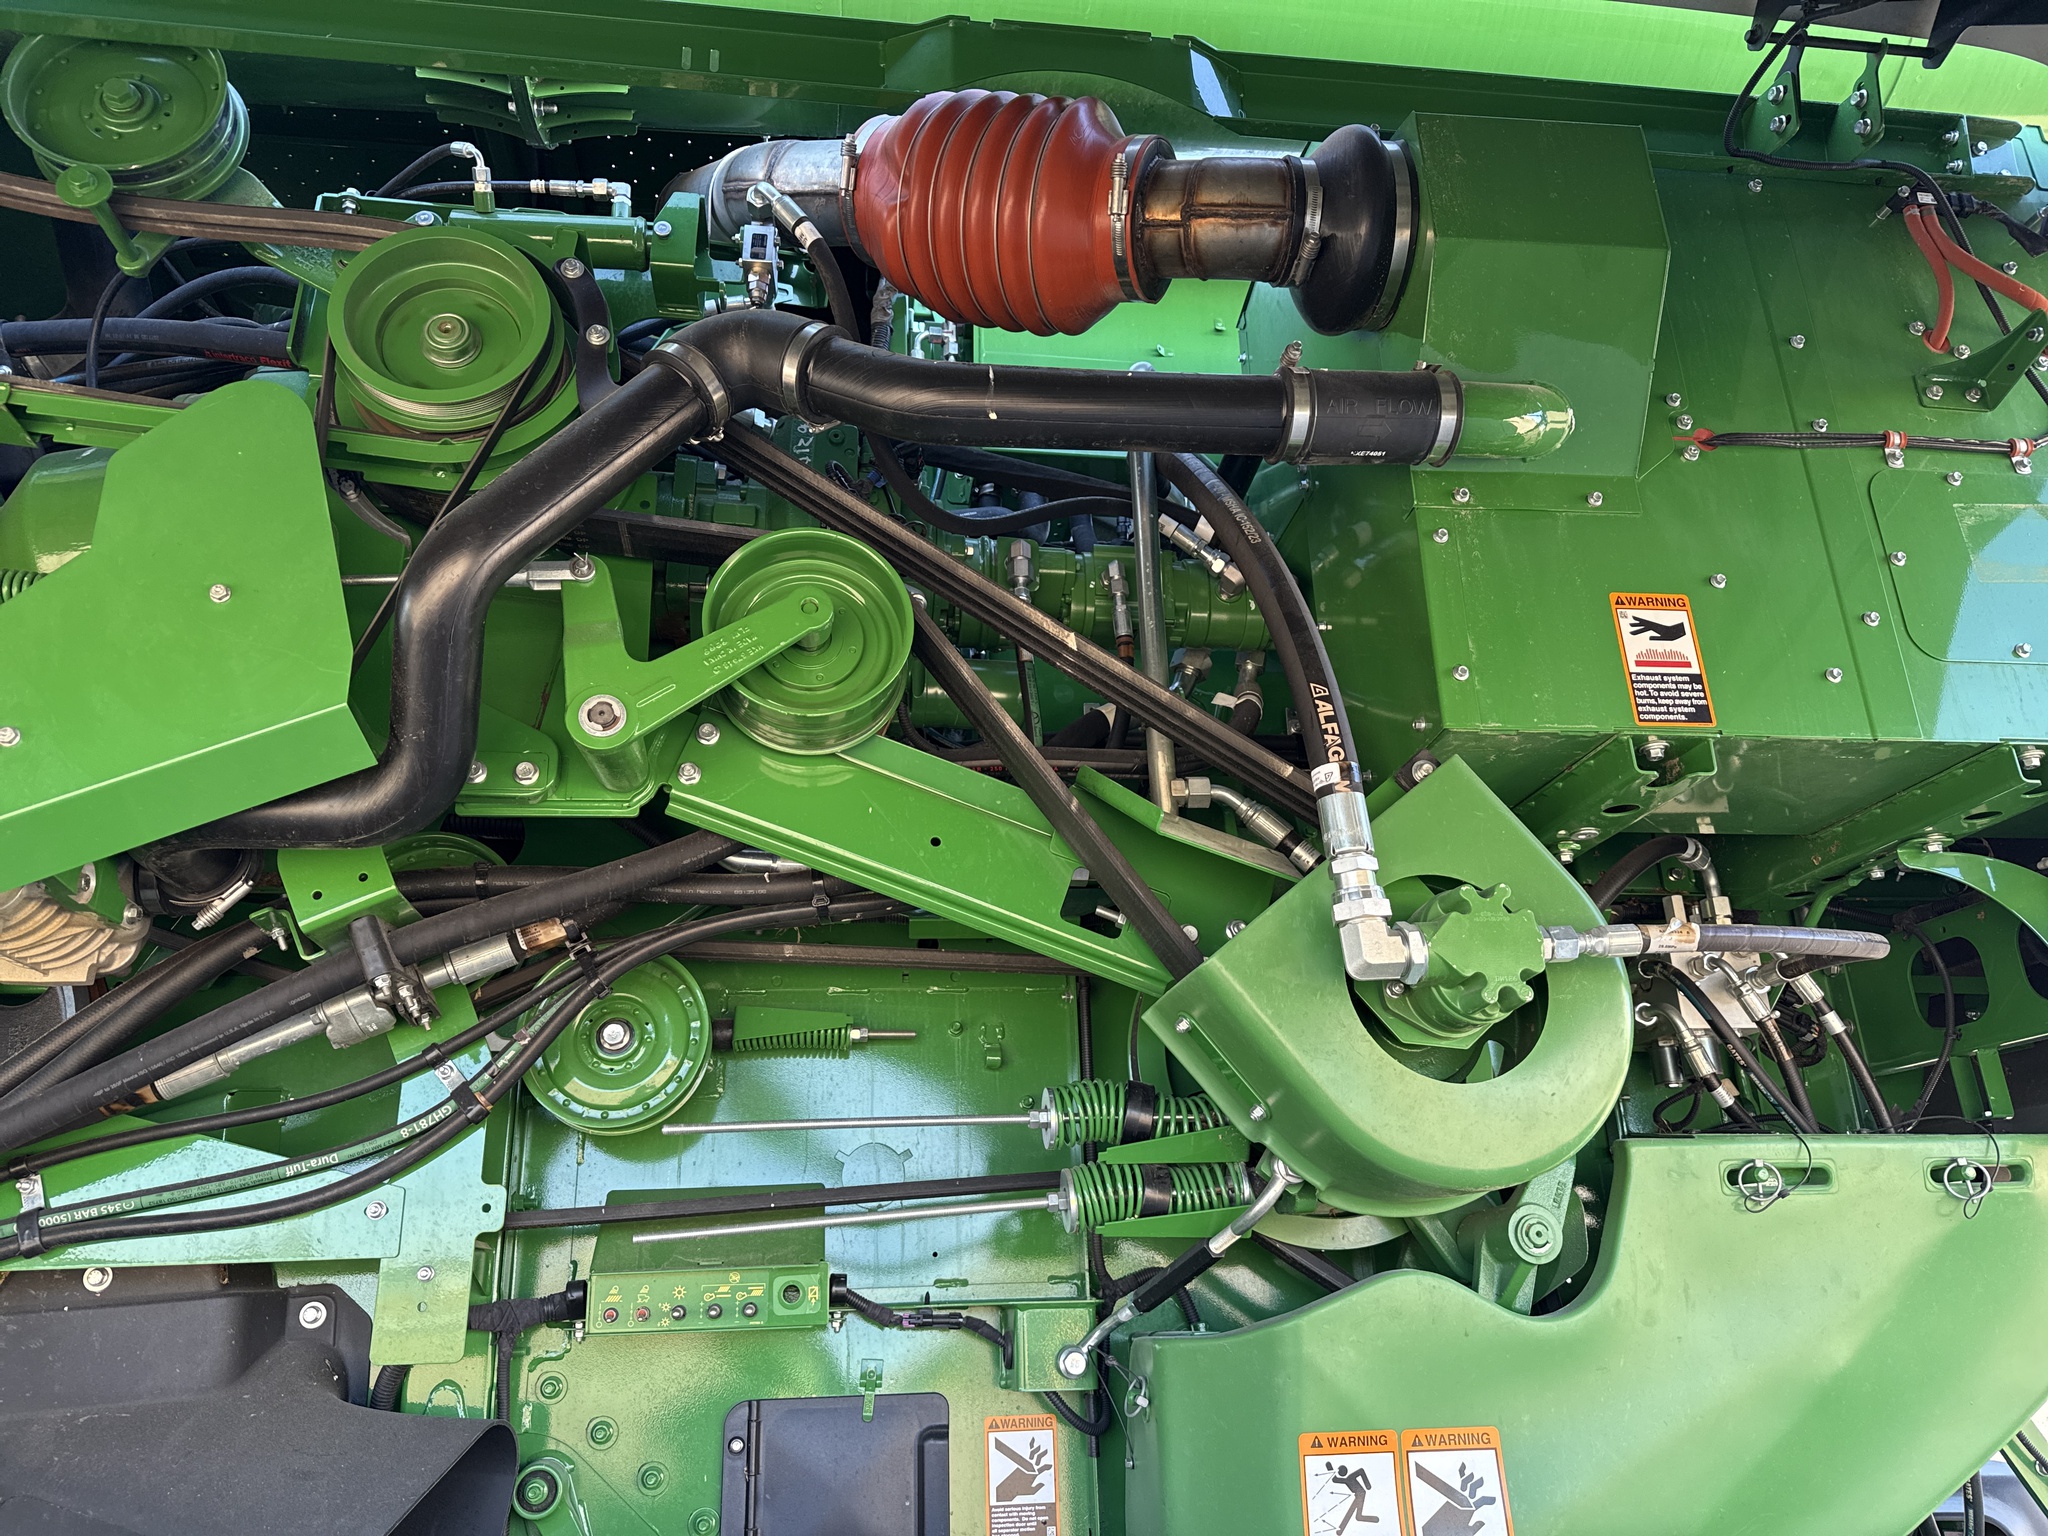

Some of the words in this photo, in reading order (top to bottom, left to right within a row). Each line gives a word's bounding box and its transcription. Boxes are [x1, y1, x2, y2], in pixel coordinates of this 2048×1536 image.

[260, 356, 292, 368] Flexit
[1326, 399, 1358, 414] AIR
[1376, 398, 1433, 415] FLOW
[1223, 496, 1241, 514] MSHA
[1234, 512, 1261, 544] IC-152/23
[1625, 596, 1686, 607] WARNING
[400, 1105, 452, 1138] GH781-8
[284, 1153, 339, 1177] Dura-Tuff
[101, 1202, 122, 1212] 345
[74, 1208, 98, 1220] BAR
[1000, 1417, 1053, 1429] WARNING
[1327, 1435, 1388, 1448] WARNING
[1425, 1432, 1491, 1446] WARNING
